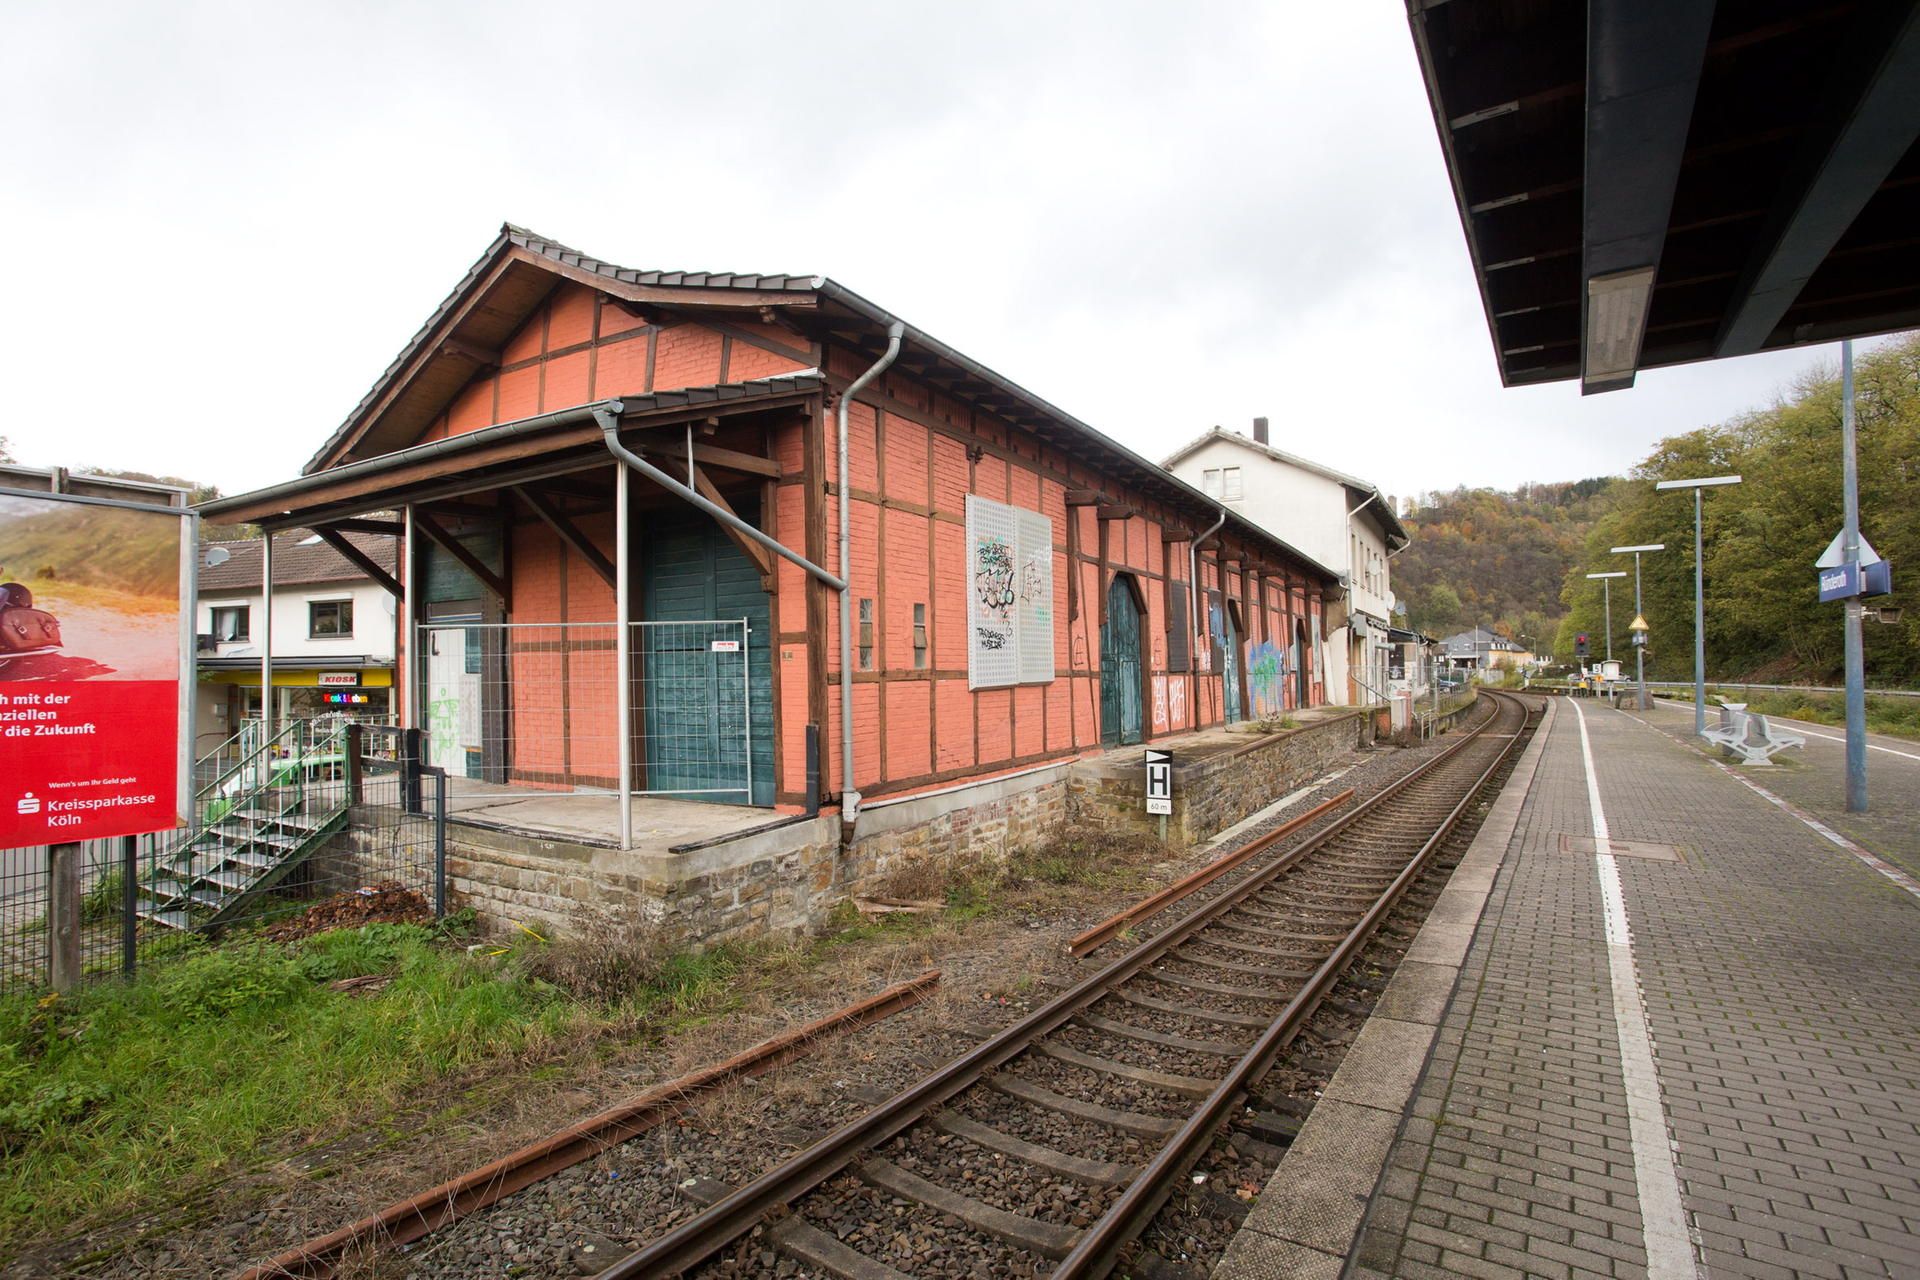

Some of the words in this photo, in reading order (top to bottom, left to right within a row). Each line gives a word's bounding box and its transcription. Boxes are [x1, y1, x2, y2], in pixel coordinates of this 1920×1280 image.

[13, 693, 41, 704] mit
[44, 693, 71, 704] der
[4, 725, 31, 737] die
[34, 723, 96, 736] Zukunft
[48, 781, 76, 789] Wenn's
[103, 777, 119, 785] Geld
[1150, 766, 1167, 796] H
[48, 794, 155, 812] Kreissparkasse
[48, 814, 82, 827] Köln
